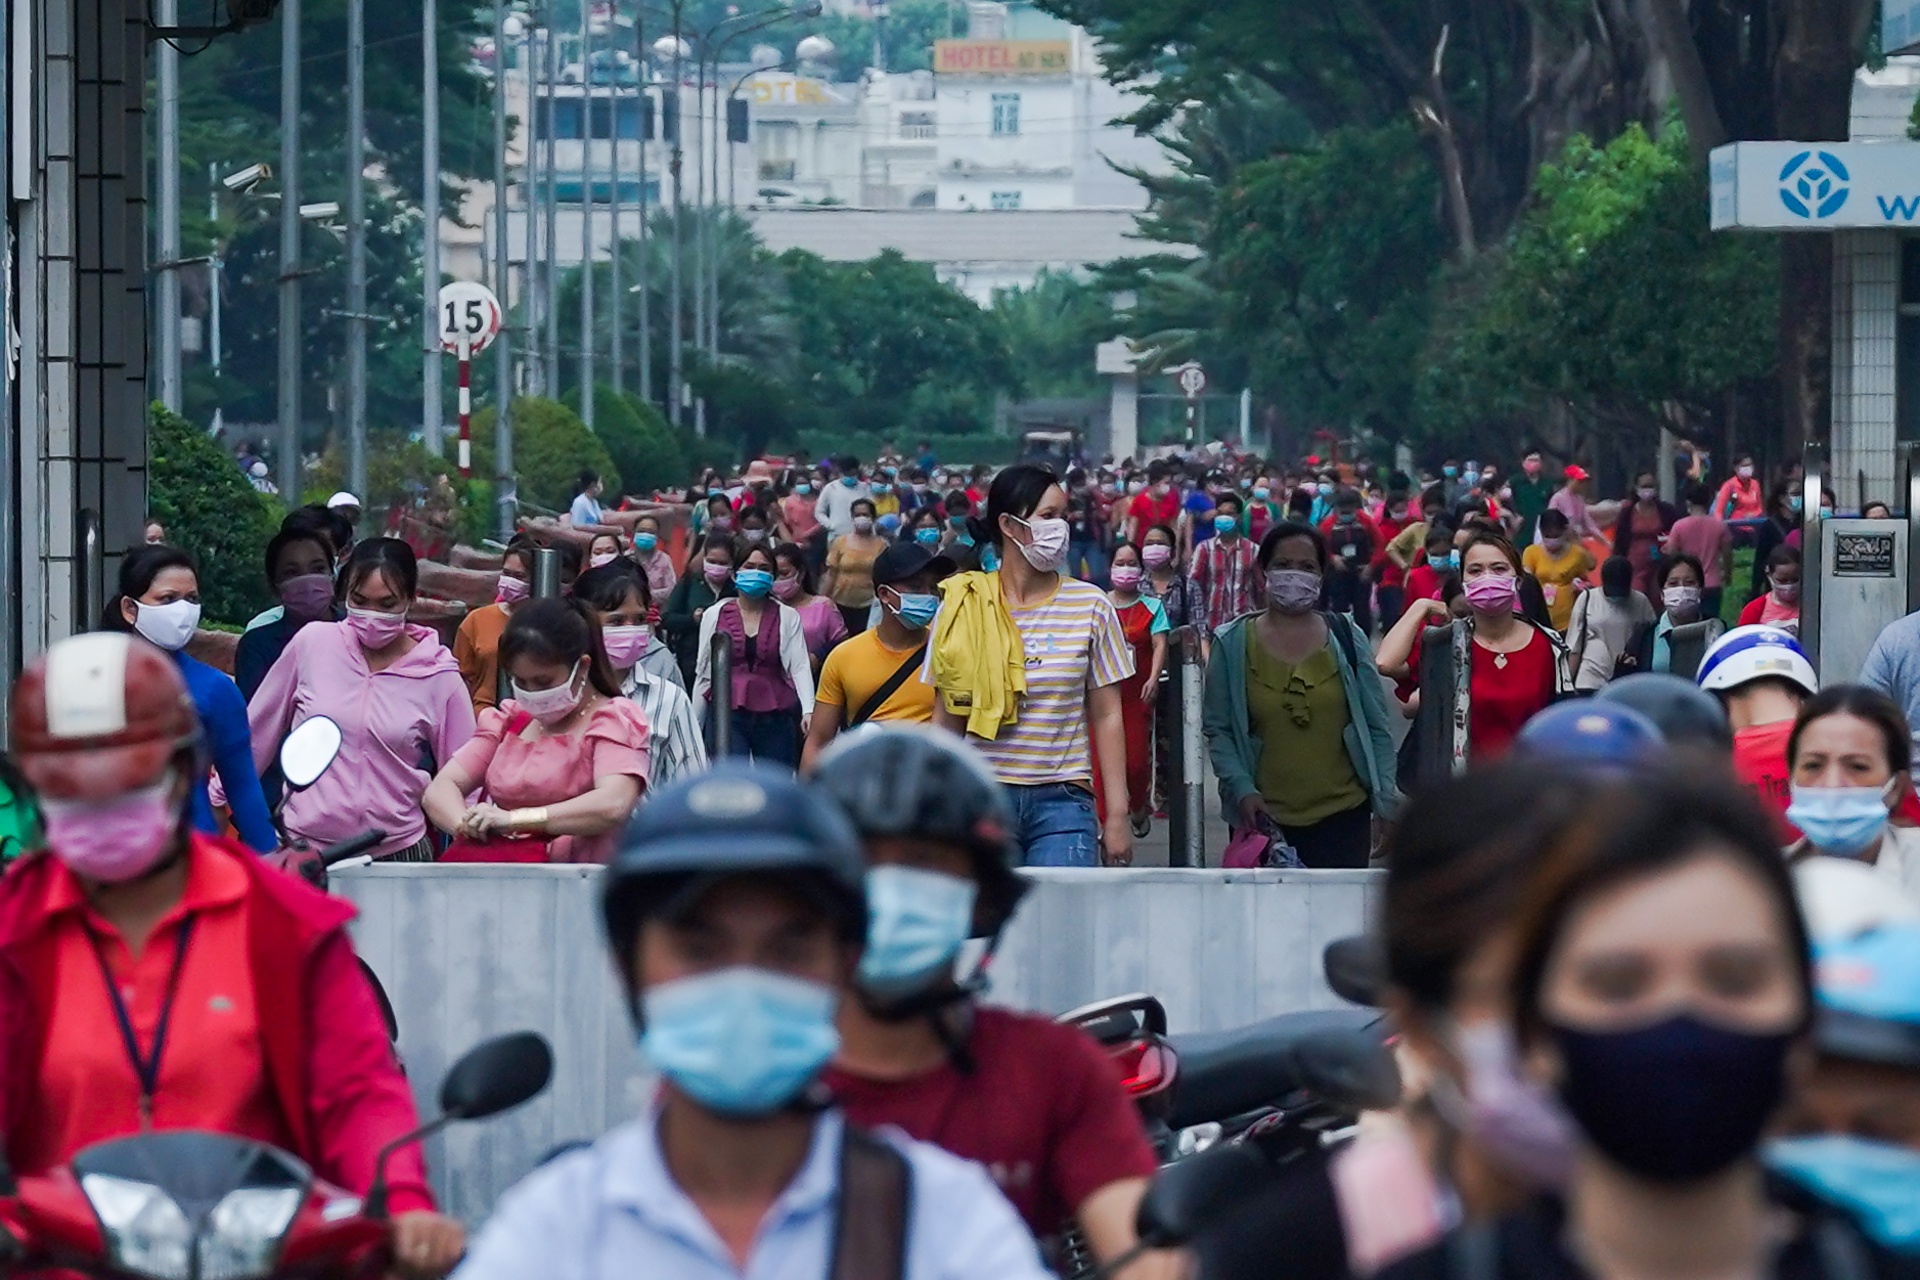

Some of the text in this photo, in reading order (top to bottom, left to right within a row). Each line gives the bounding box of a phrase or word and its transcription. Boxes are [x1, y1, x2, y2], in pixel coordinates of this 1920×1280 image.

[942, 46, 1014, 68] HOTEL
[734, 80, 831, 102] OTEL
[445, 300, 483, 334] 15
